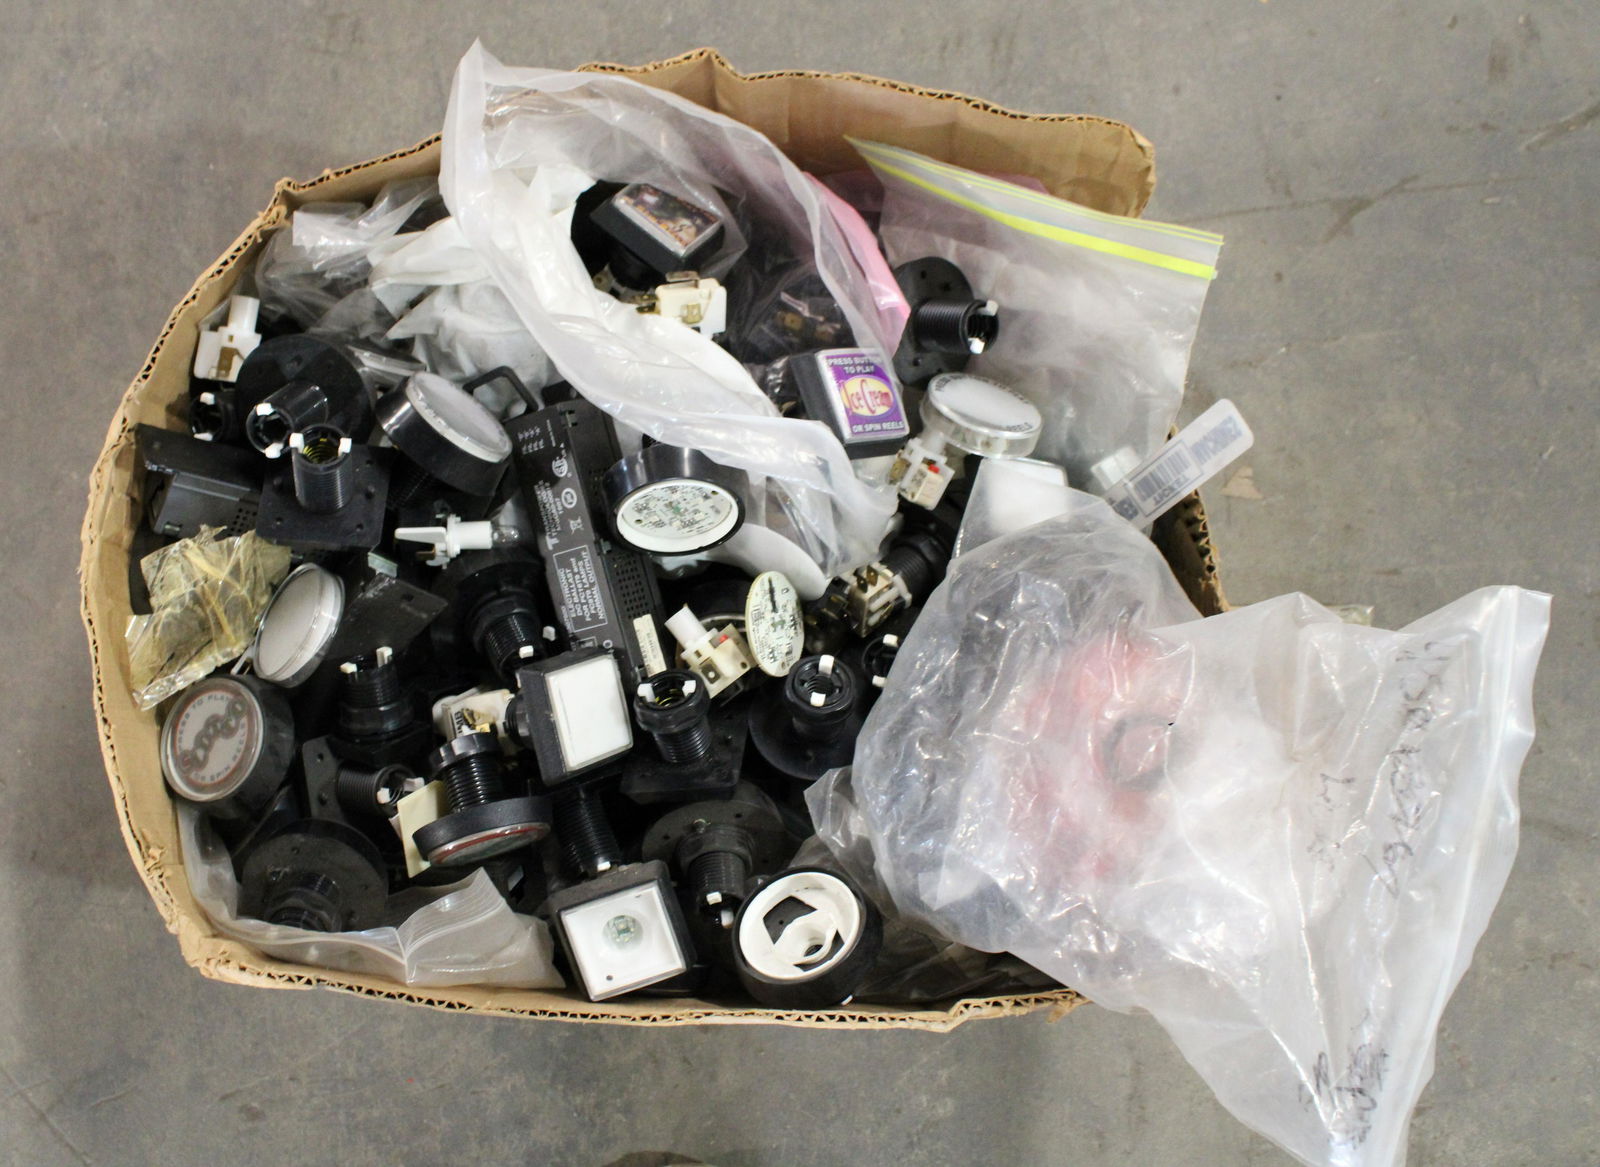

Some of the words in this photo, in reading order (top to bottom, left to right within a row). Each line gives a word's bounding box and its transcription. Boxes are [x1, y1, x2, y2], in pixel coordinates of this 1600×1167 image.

[828, 357, 854, 367] PRESS
[844, 366, 856, 375] TO
[857, 365, 876, 374] PLAY
[853, 424, 864, 433] OR
[864, 423, 881, 433] SPIN
[882, 421, 905, 431] REELS
[577, 560, 589, 587] LAMPS
[581, 550, 594, 583] OUTPUT
[558, 567, 576, 617] ELECTRONIC
[565, 567, 579, 603] BALLAST
[574, 603, 582, 616] DC
[582, 604, 591, 621] FOR
[591, 586, 604, 619] NORMAL
